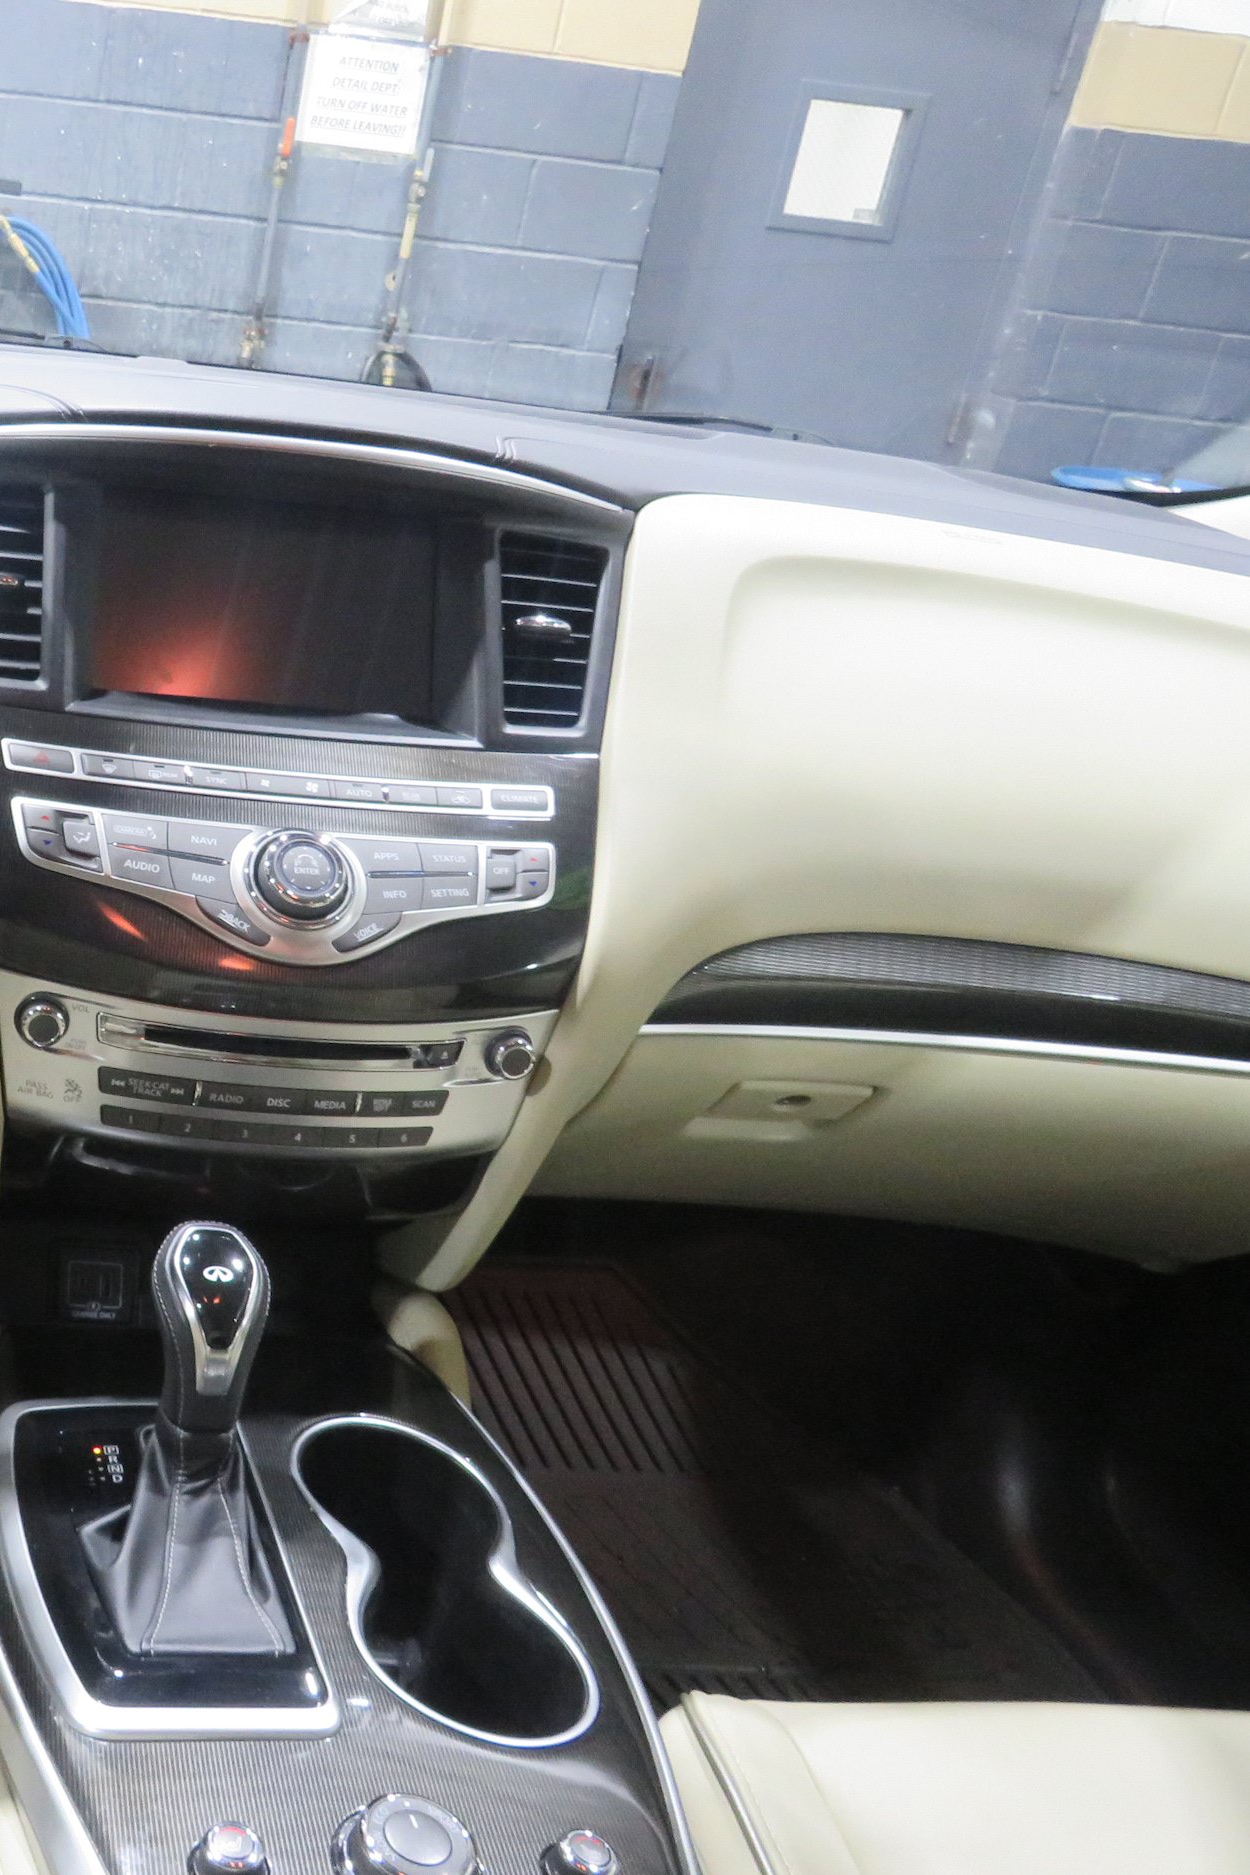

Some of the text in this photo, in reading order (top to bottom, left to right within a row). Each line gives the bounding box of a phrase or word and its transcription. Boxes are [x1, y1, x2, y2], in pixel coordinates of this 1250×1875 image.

[339, 56, 399, 72] ATTENTION
[332, 76, 368, 91] DETAIL
[317, 96, 408, 117] TURN OFF WATER
[310, 115, 407, 136] BEFORE LEAVING!!
[205, 776, 228, 786] SYNC
[346, 788, 373, 798] AUTO
[190, 834, 218, 846] NAVI
[373, 851, 400, 861] APPS
[432, 854, 467, 864] STATUS
[123, 858, 160, 874] AUDIO
[294, 866, 321, 876] ENTER
[191, 873, 216, 884] MAP
[382, 889, 407, 899] INFO
[430, 887, 470, 898] SETTING
[227, 913, 250, 932] BACK
[354, 922, 378, 942] VOICE
[71, 1003, 91, 1014] VOL
[25, 1079, 49, 1091] PASS
[209, 1093, 244, 1105] RADIO
[266, 1097, 291, 1109] DISC
[313, 1099, 347, 1110] MEDIA
[412, 1099, 435, 1109] SCAN
[184, 1123, 191, 1133] 2
[242, 1129, 248, 1138] 3
[294, 1133, 301, 1142] 4
[349, 1134, 356, 1144] 5
[401, 1133, 408, 1143] 6
[108, 1455, 118, 1464] R
[112, 1474, 123, 1483] D
